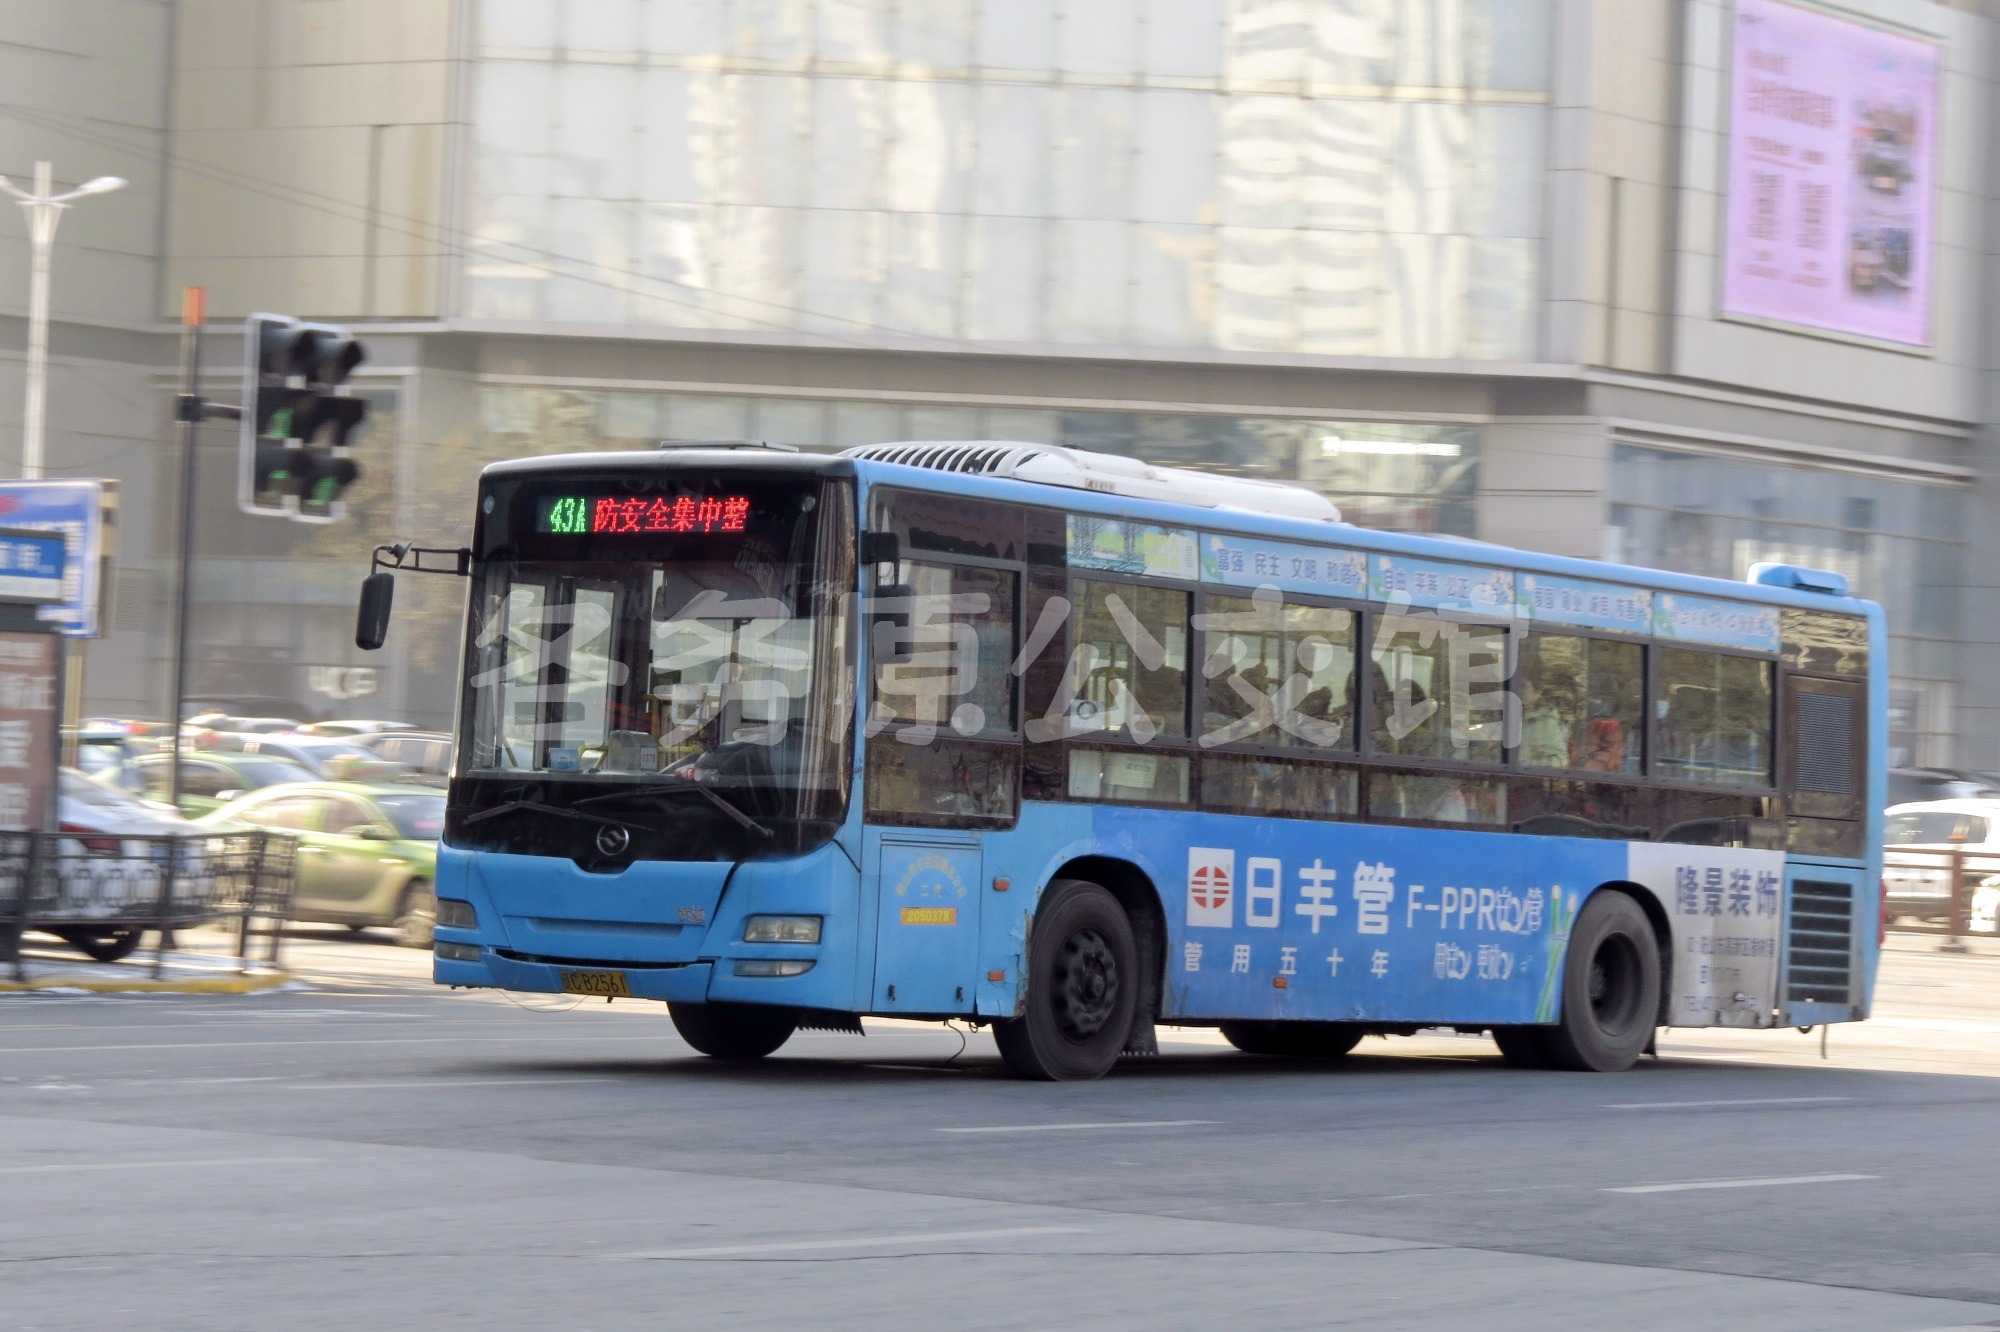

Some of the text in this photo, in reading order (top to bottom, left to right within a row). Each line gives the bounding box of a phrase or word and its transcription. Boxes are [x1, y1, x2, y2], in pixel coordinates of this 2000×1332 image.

[593, 497, 749, 533] 防安全集中整
[1255, 553, 1280, 577] 民主
[1291, 557, 1317, 580] 文明
[1245, 857, 1396, 935] 日丰管
[1676, 865, 1780, 919] 隆景装饰
[907, 910, 949, 922] 2050378
[1184, 941, 1390, 979] 管用五十年
